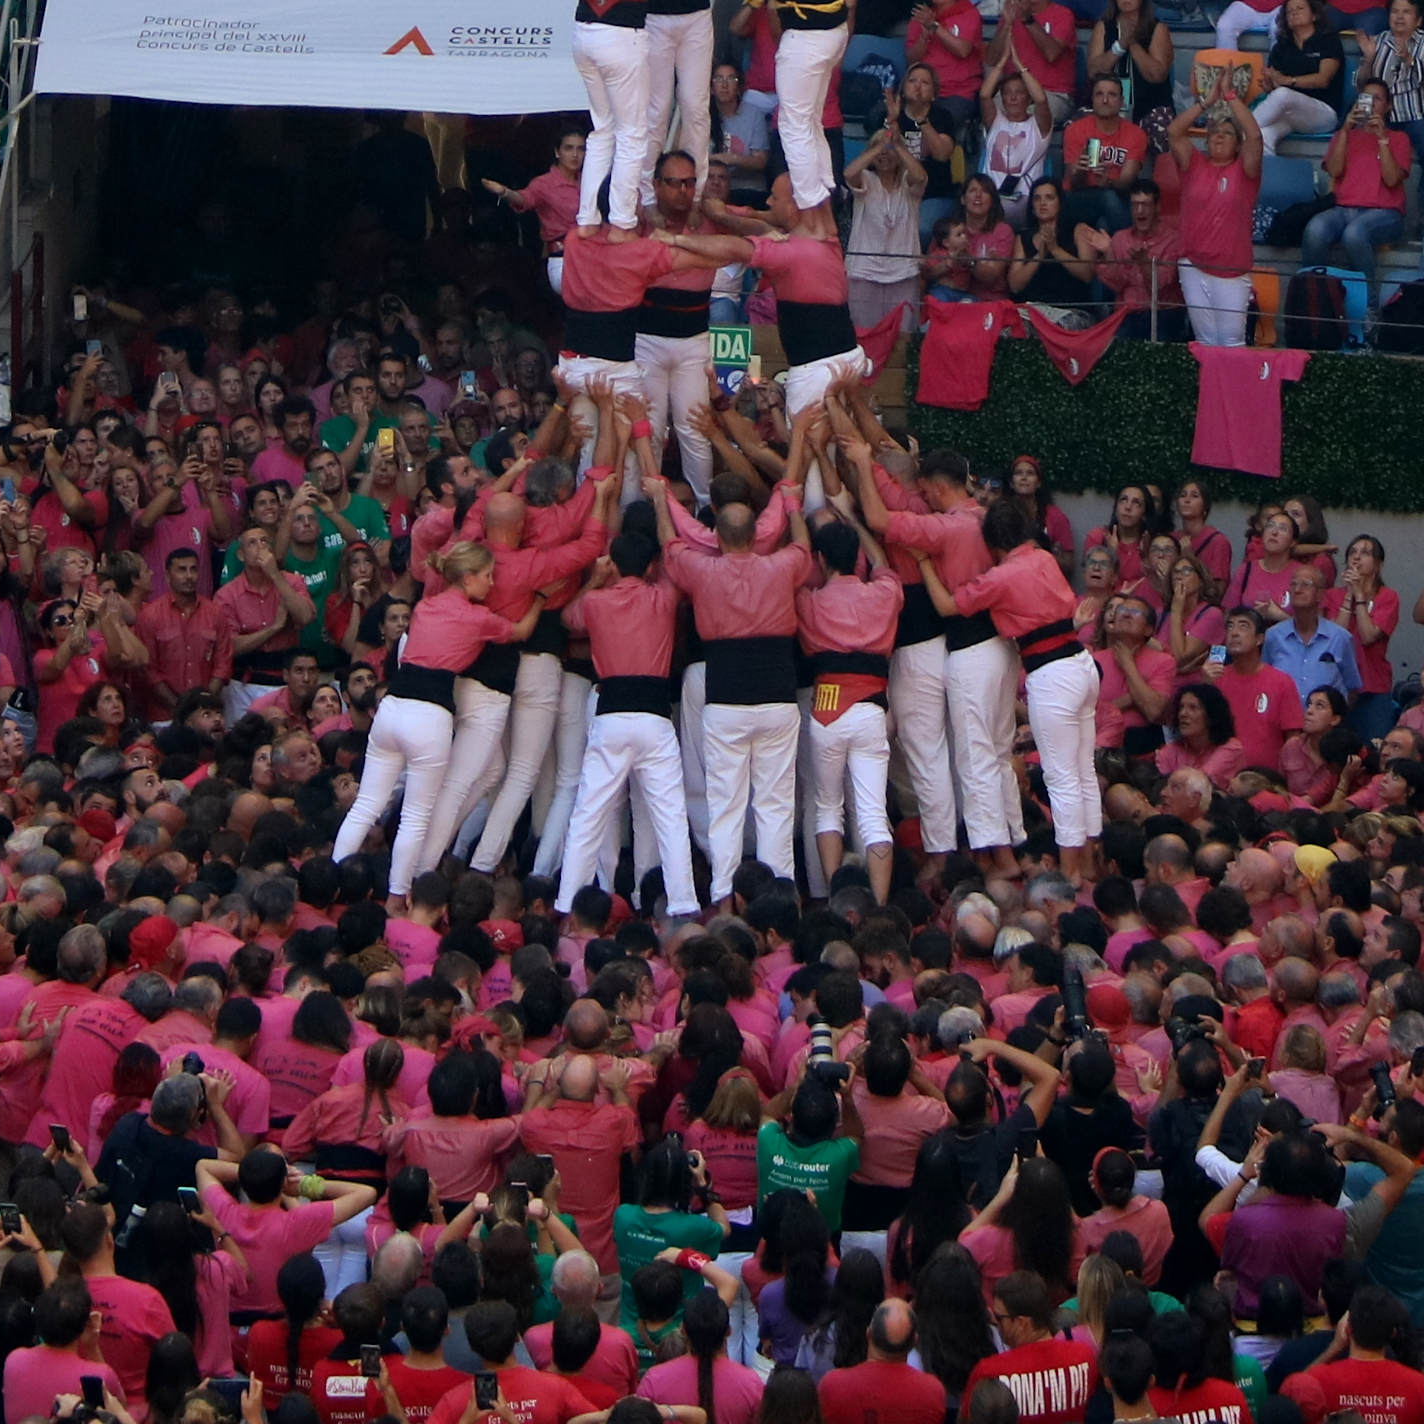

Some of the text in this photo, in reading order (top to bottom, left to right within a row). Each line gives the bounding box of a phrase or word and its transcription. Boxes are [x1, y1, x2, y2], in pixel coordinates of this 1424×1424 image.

[143, 16, 260, 30] Patrocinador
[139, 29, 216, 42] principal
[223, 32, 250, 41] del
[451, 27, 554, 36] CONCURS
[136, 39, 316, 54] Concurs de Castells
[448, 36, 552, 45] CASTELLS
[447, 49, 550, 58] TARRAGONA
[1068, 1361, 1090, 1408] PIT
[521, 1398, 537, 1412] per
[1338, 1393, 1406, 1410] nascuts per
